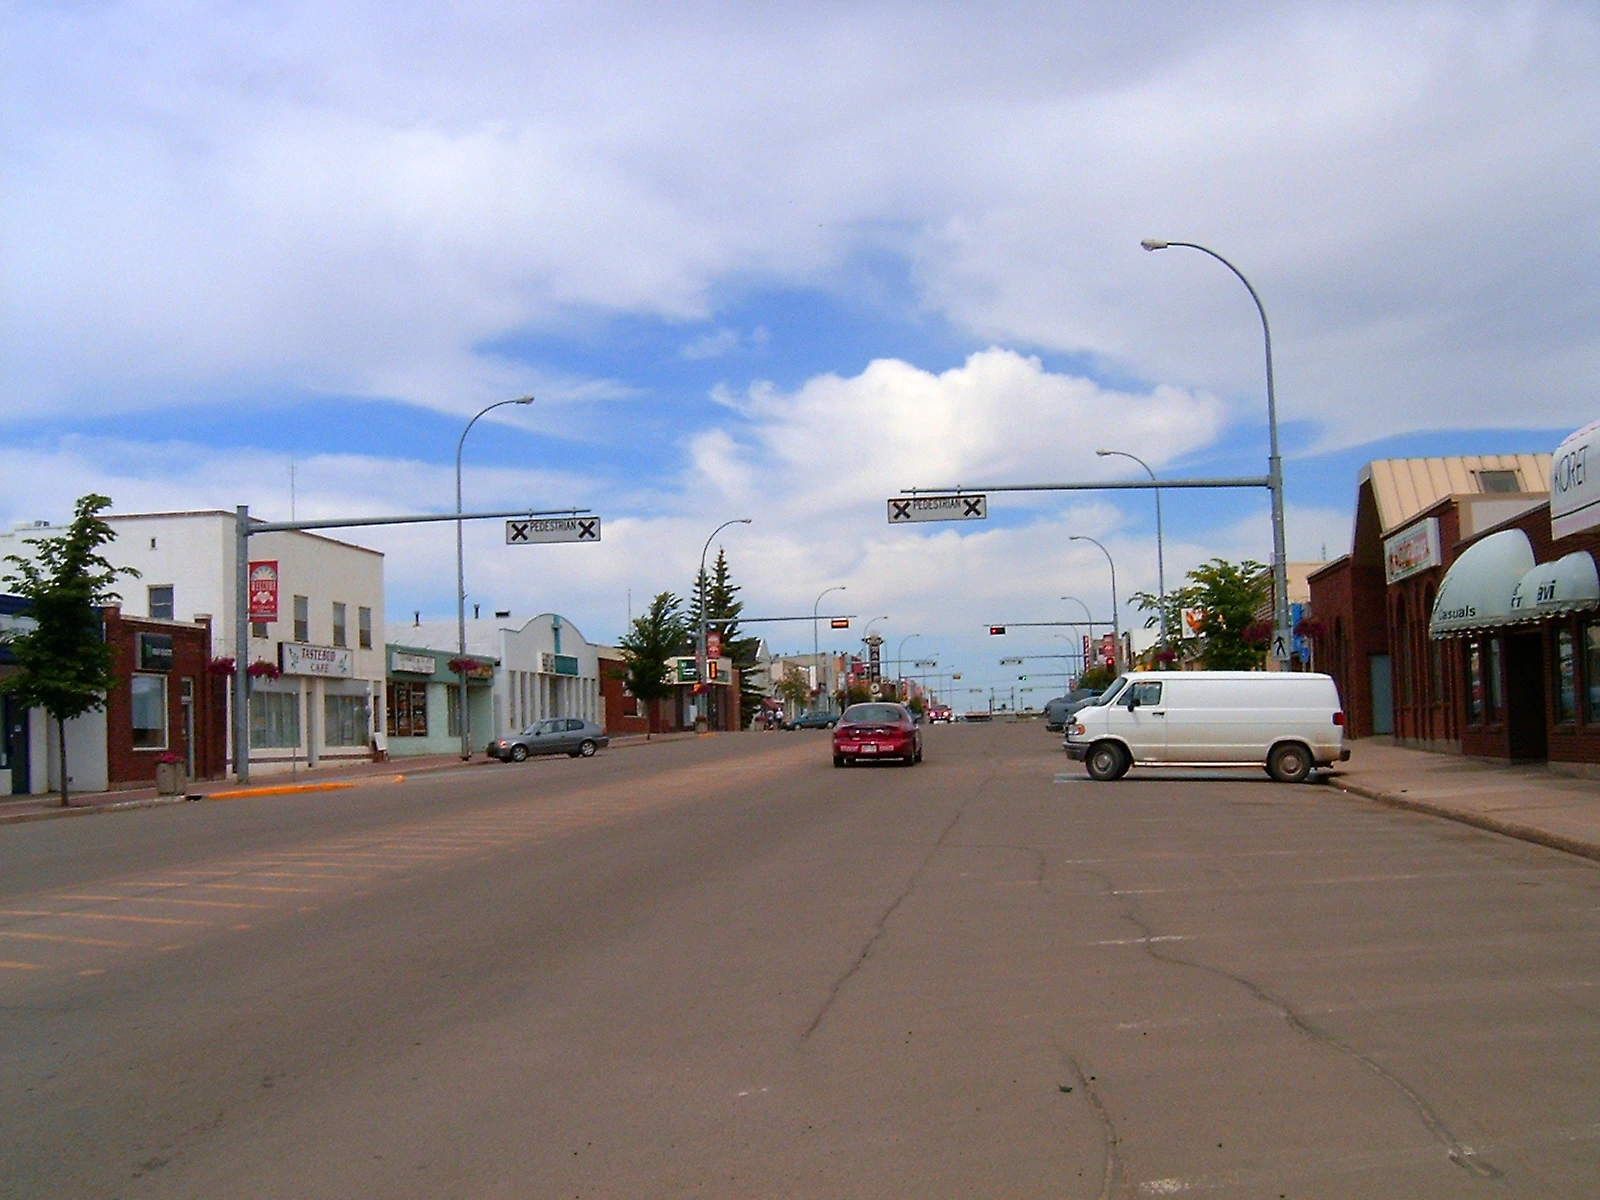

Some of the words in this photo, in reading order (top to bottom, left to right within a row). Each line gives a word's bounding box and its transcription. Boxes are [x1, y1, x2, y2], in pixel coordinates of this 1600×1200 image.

[1554, 445, 1587, 495] KORET
[913, 498, 960, 510] PEDESTRIAN
[529, 519, 576, 532] PEDESTRIAN
